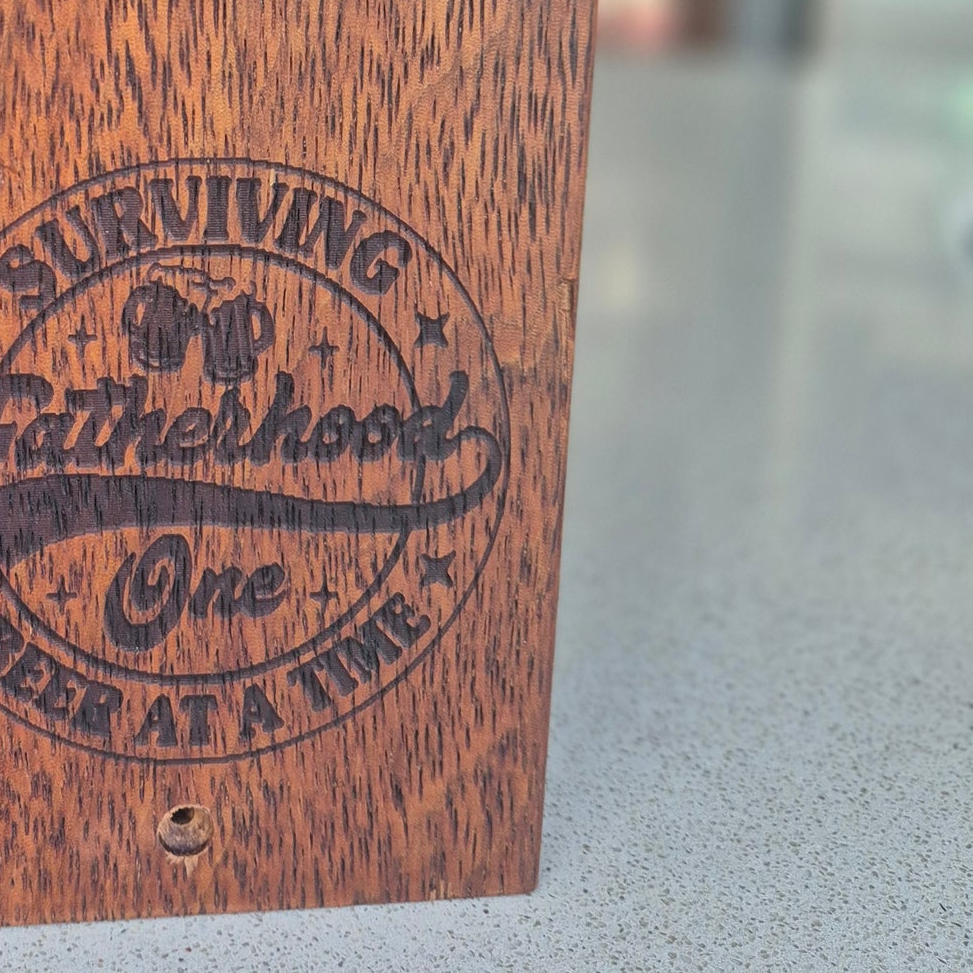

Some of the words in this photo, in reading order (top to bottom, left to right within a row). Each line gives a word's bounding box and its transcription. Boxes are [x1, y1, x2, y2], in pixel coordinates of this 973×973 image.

[104, 533, 291, 653] One
[134, 693, 218, 747] AT
[240, 684, 285, 740] A
[286, 591, 432, 713] TIME
